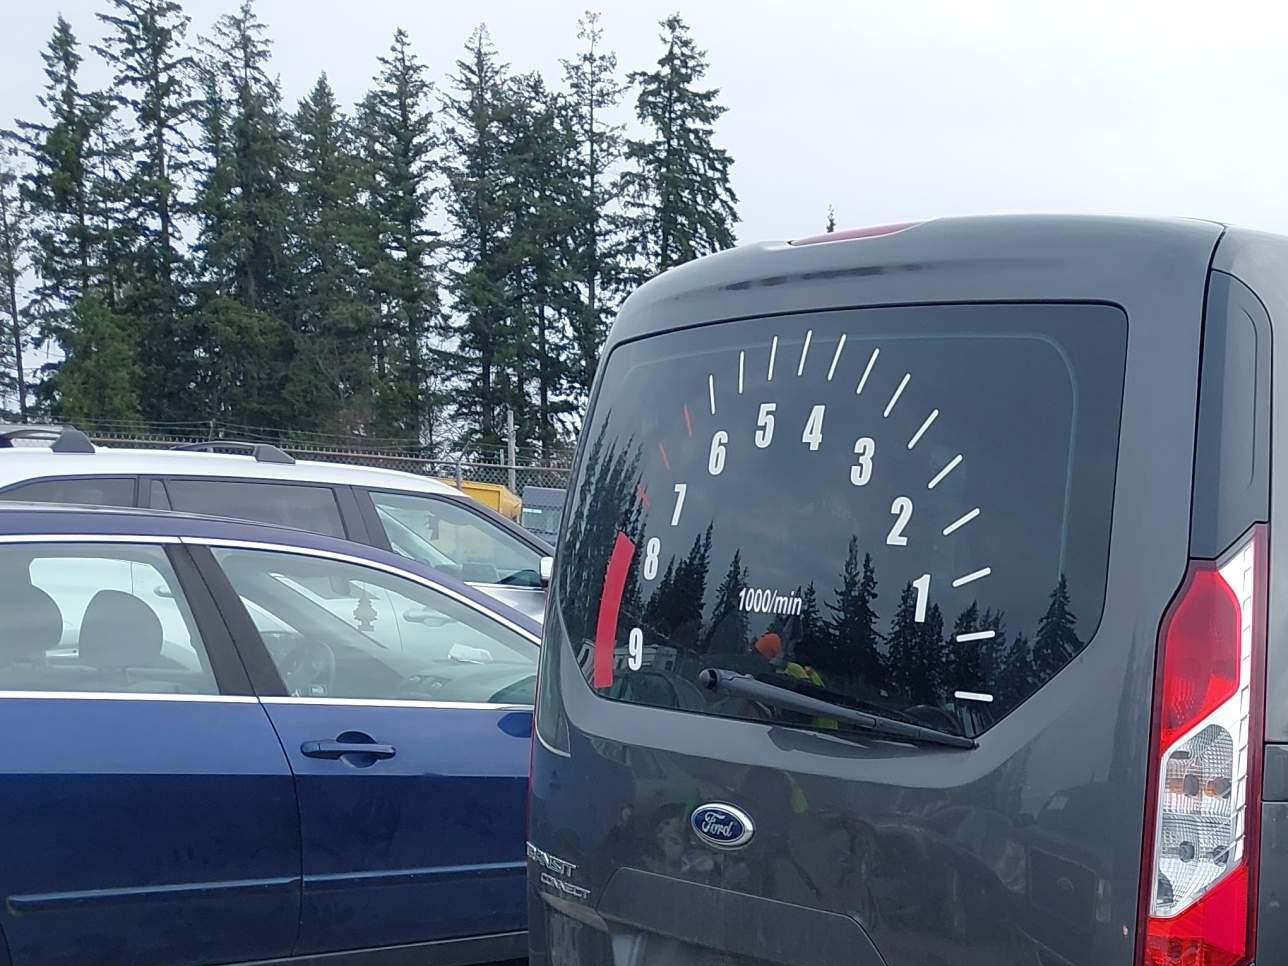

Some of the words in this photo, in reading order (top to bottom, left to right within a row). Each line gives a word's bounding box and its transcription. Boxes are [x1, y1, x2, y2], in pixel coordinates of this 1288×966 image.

[754, 402, 777, 449] 5
[801, 404, 826, 451] 4
[708, 430, 729, 476] 6
[850, 437, 876, 486] 3
[670, 483, 688, 526] 7
[886, 496, 913, 546] 2
[643, 536, 661, 581] 8
[738, 587, 802, 616] 1000/min
[912, 573, 931, 623] 1
[627, 627, 644, 671] 9
[701, 811, 734, 837] Ford
